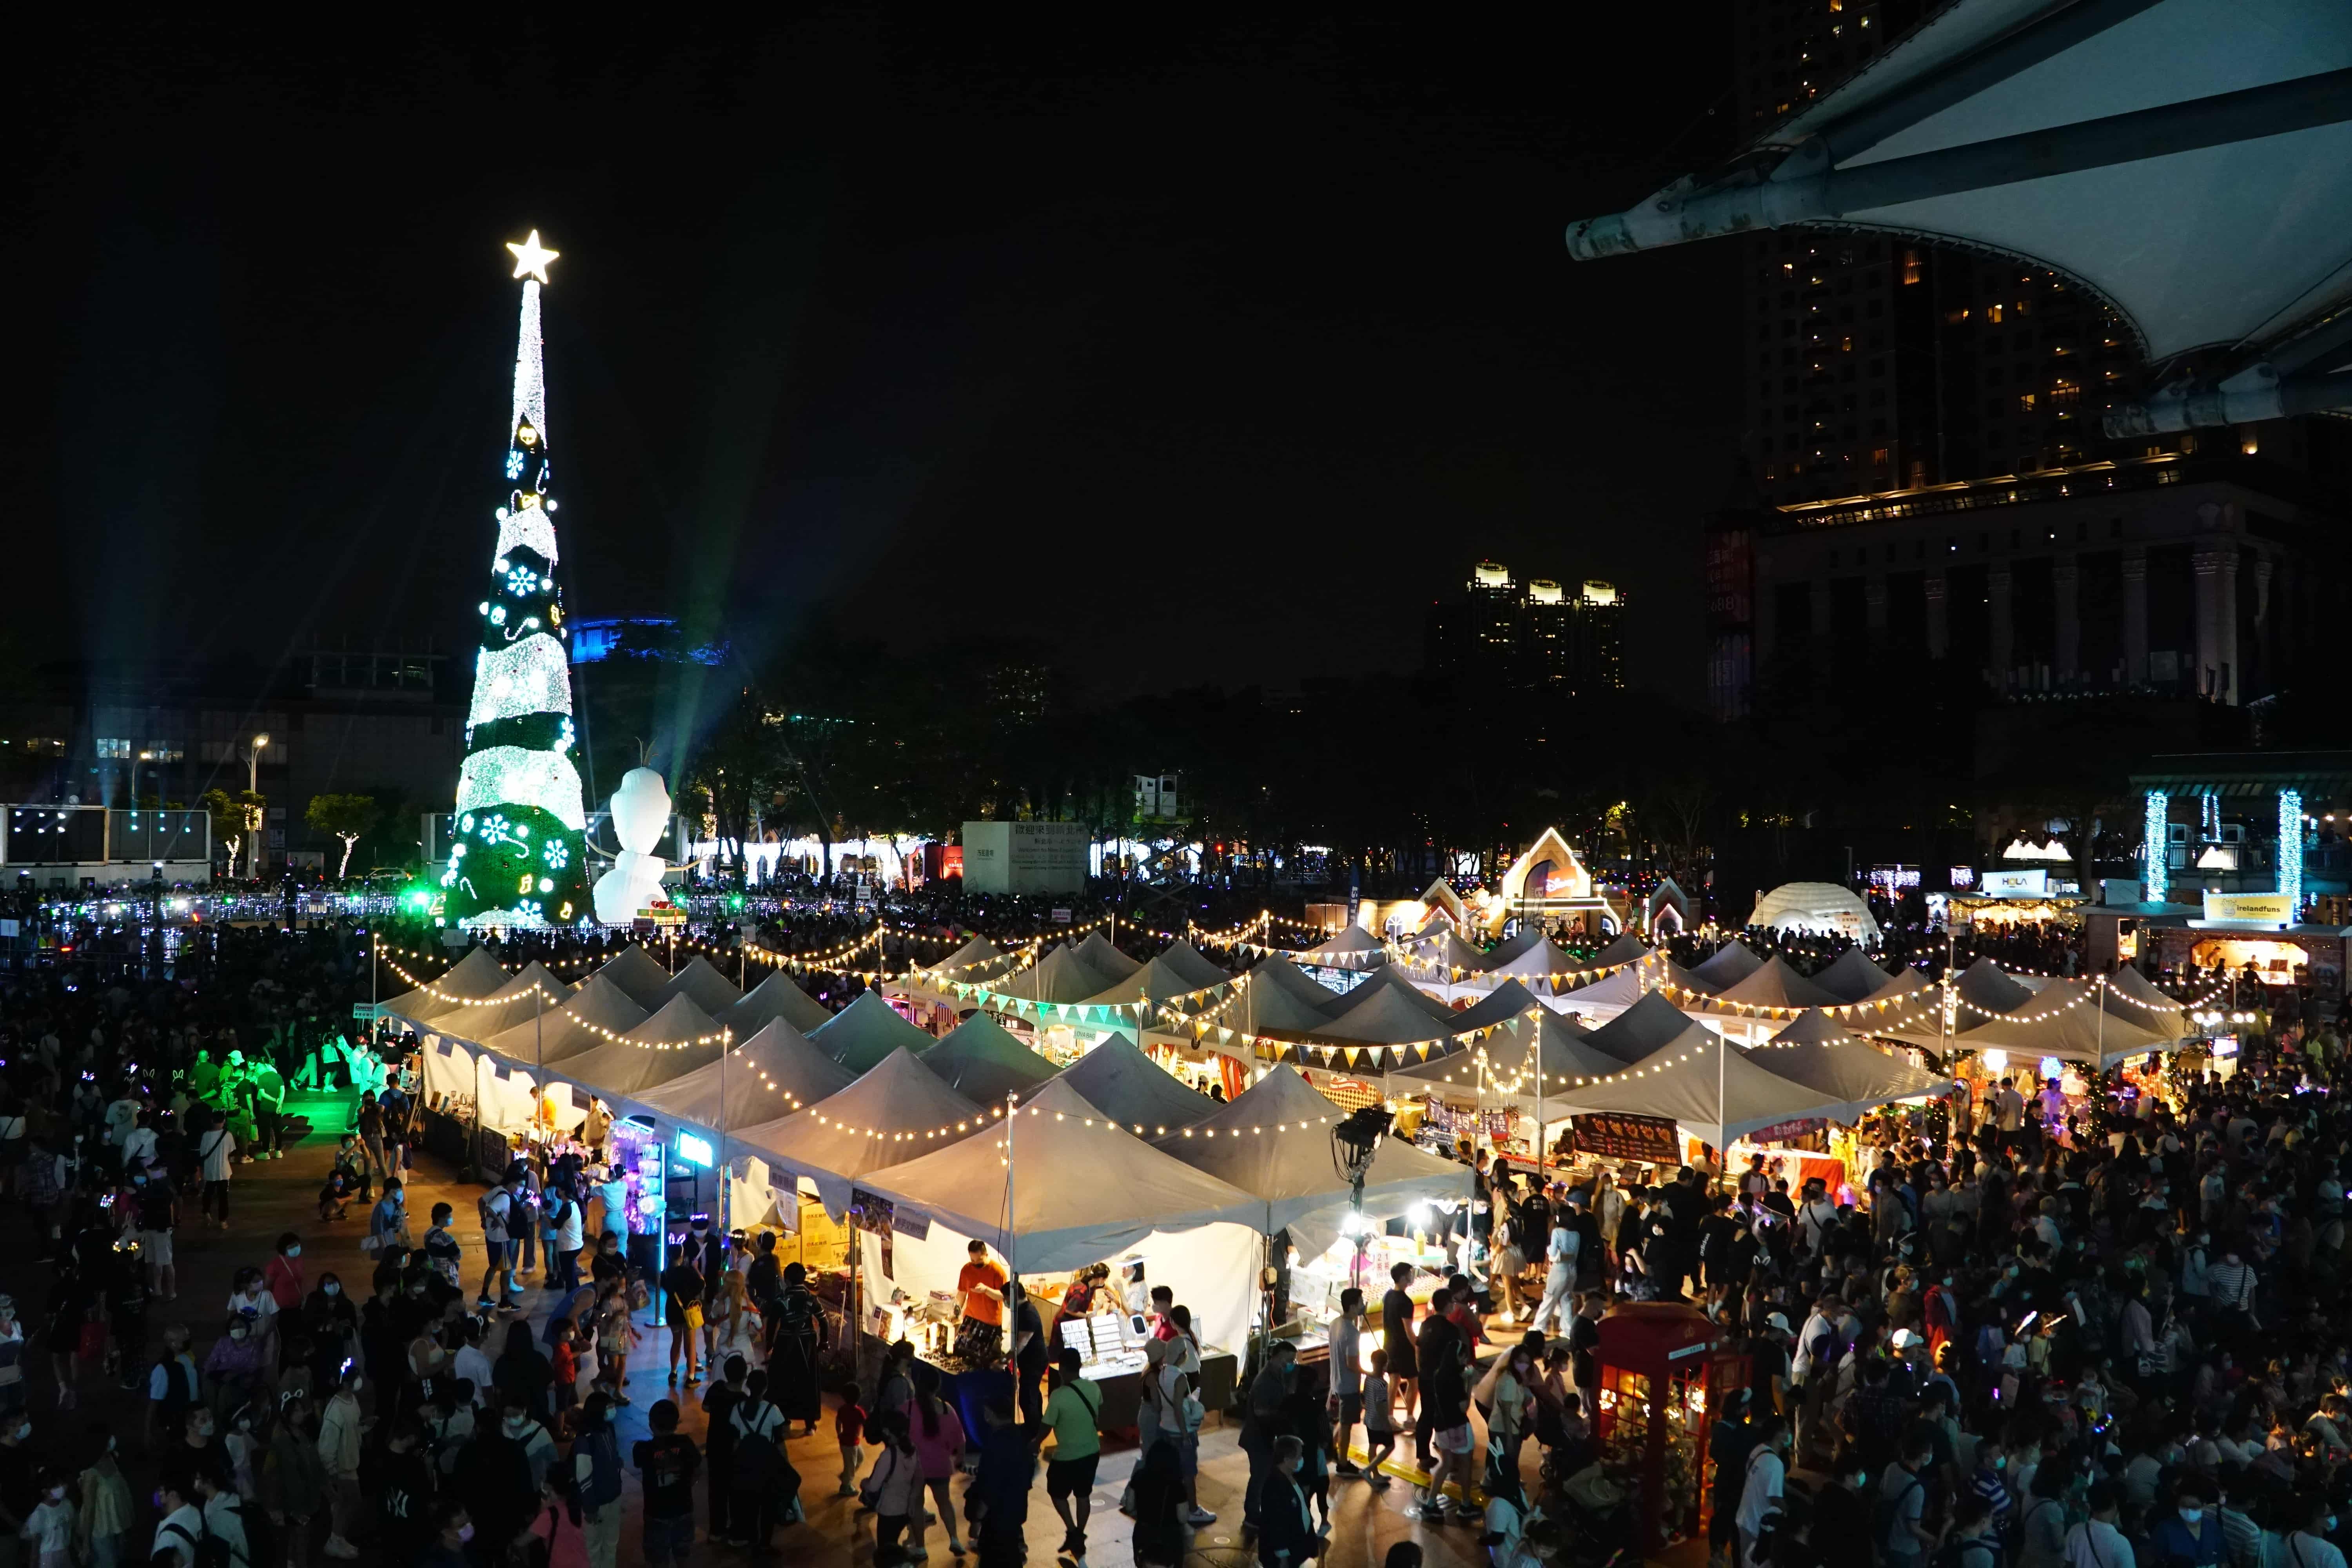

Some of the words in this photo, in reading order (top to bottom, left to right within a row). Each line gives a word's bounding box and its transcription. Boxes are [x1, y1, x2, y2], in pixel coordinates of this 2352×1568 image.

[2002, 878, 2027, 886] HOLA
[2236, 904, 2281, 913] irelandfuns
[1699, 1232, 1711, 1257] adidas
